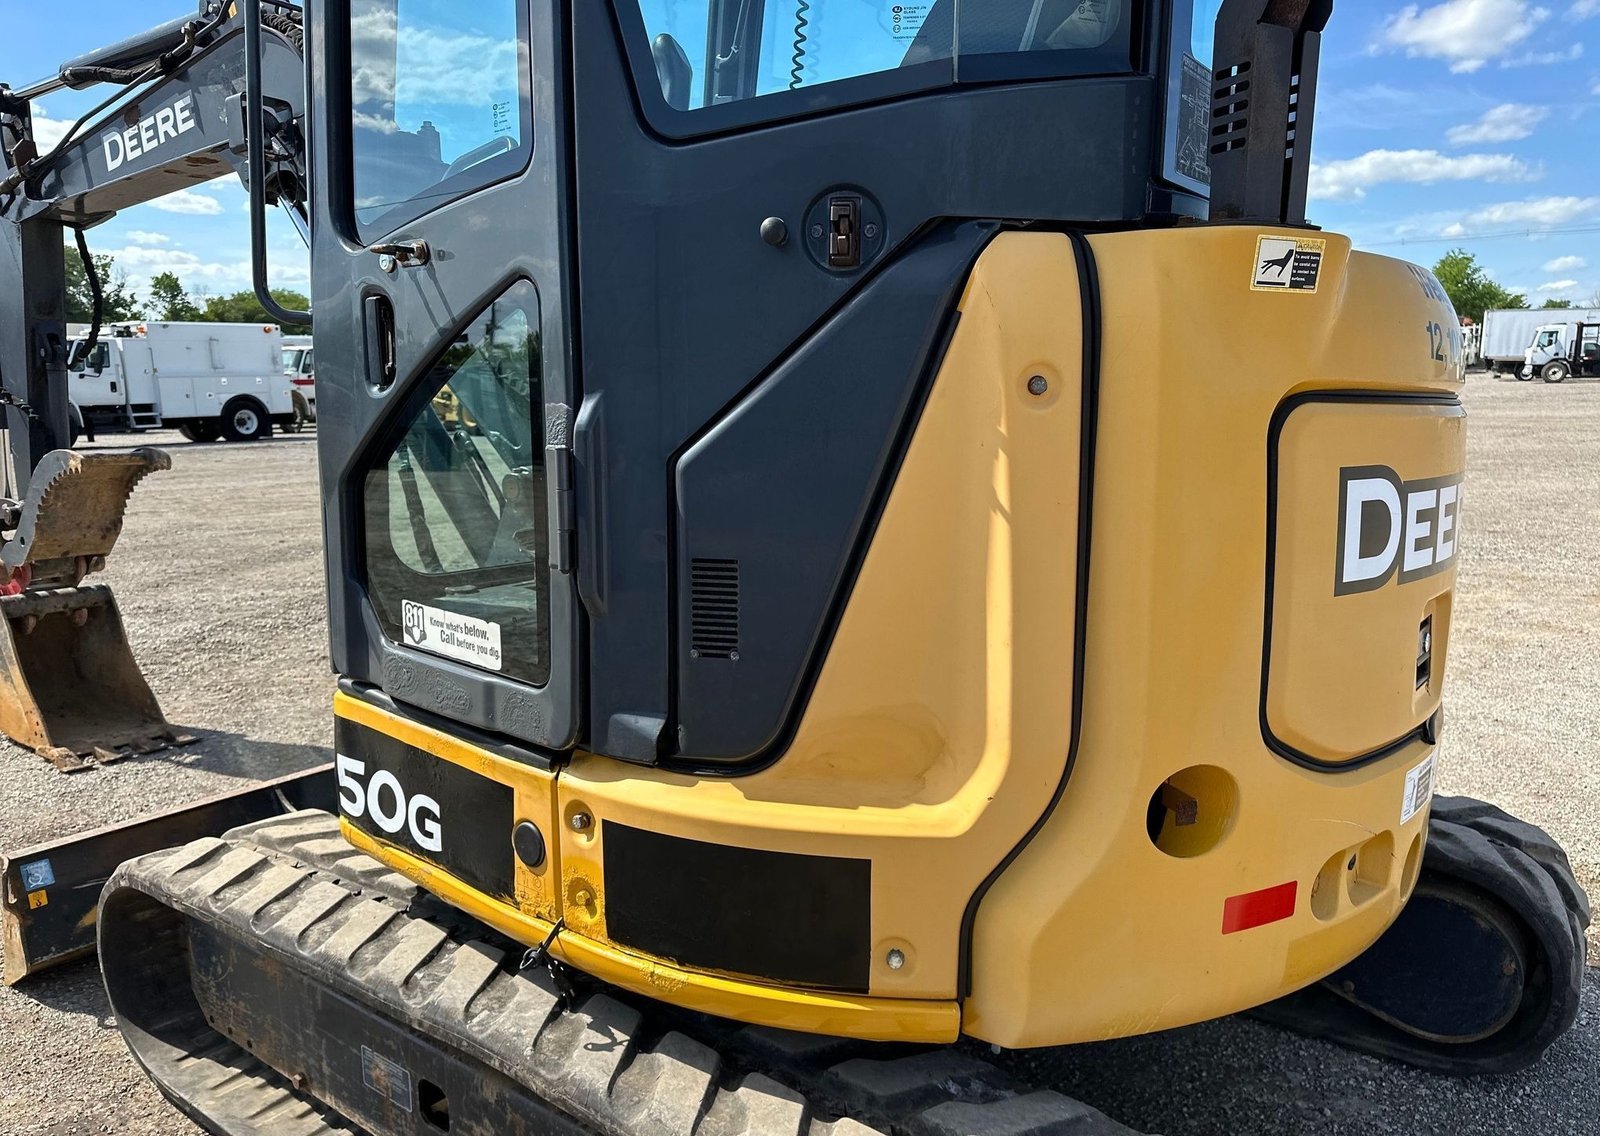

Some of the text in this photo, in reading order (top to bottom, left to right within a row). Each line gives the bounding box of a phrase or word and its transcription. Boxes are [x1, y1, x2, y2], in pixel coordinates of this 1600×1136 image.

[102, 95, 195, 172] DEERE
[1343, 477, 1464, 583] DEE
[404, 602, 424, 631] 811
[429, 617, 489, 641] Know what's below.
[440, 629, 455, 646] Call
[456, 637, 476, 651] before
[476, 644, 488, 655] you
[336, 752, 443, 852] 50G
